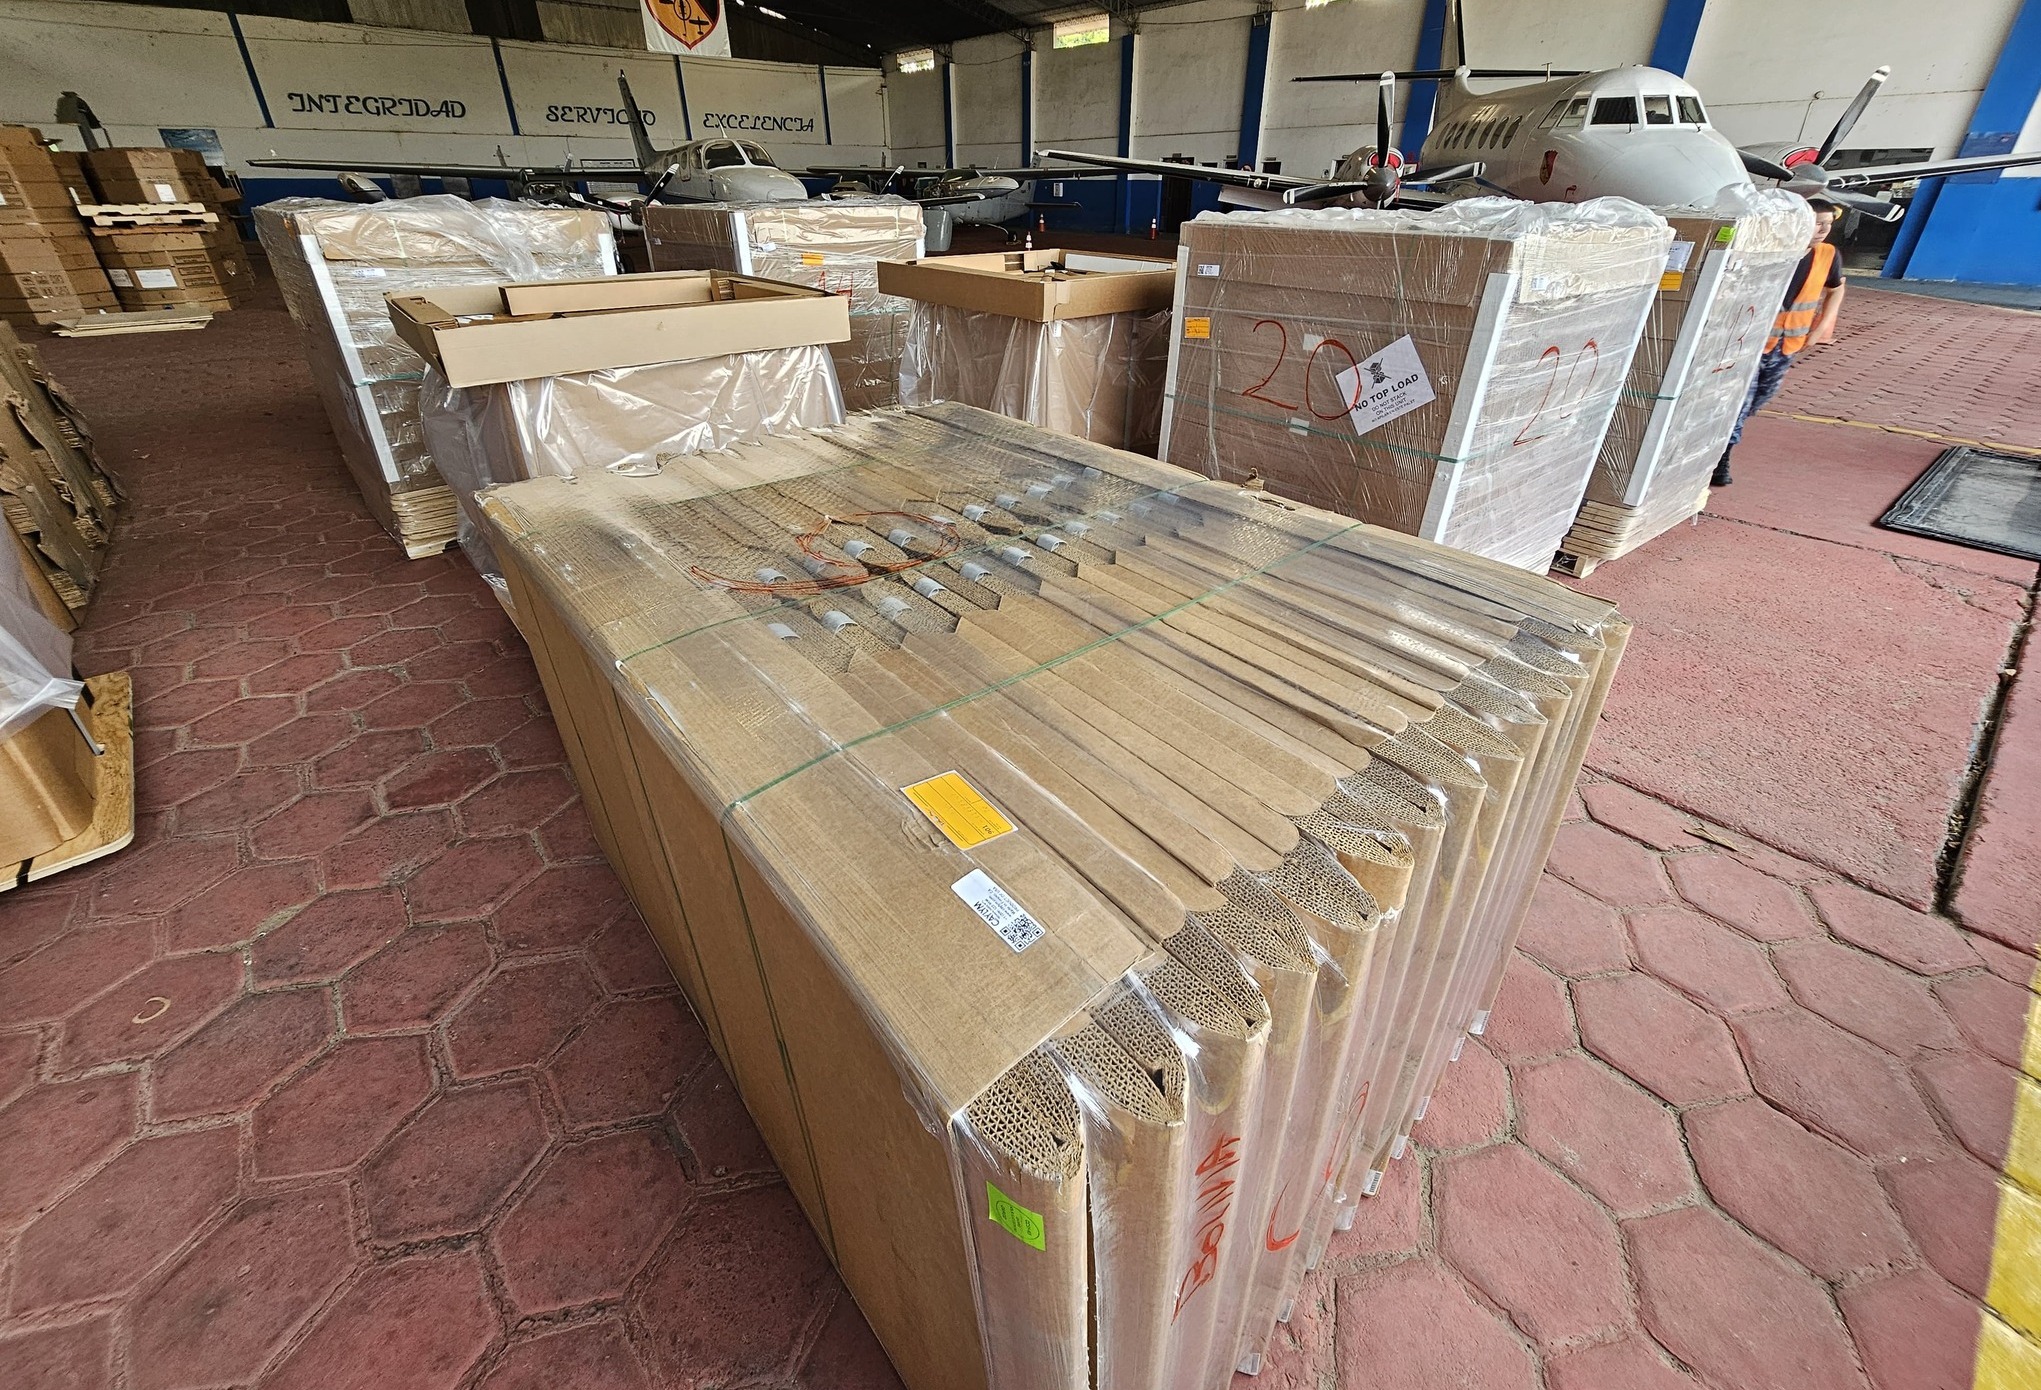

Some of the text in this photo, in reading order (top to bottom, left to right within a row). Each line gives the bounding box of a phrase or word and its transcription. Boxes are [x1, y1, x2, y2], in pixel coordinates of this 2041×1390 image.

[288, 92, 466, 118] INTEGRIDAD
[546, 105, 656, 126] SERVICO
[703, 113, 814, 133] EXCELENCIA
[1241, 319, 1362, 420] 20
[1354, 374, 1418, 412] NO TOP LOAD
[1390, 392, 1407, 402] STACK
[1395, 398, 1406, 406] UNIT
[1513, 337, 1599, 446] 20
[974, 901, 1000, 926] CAYLYM
